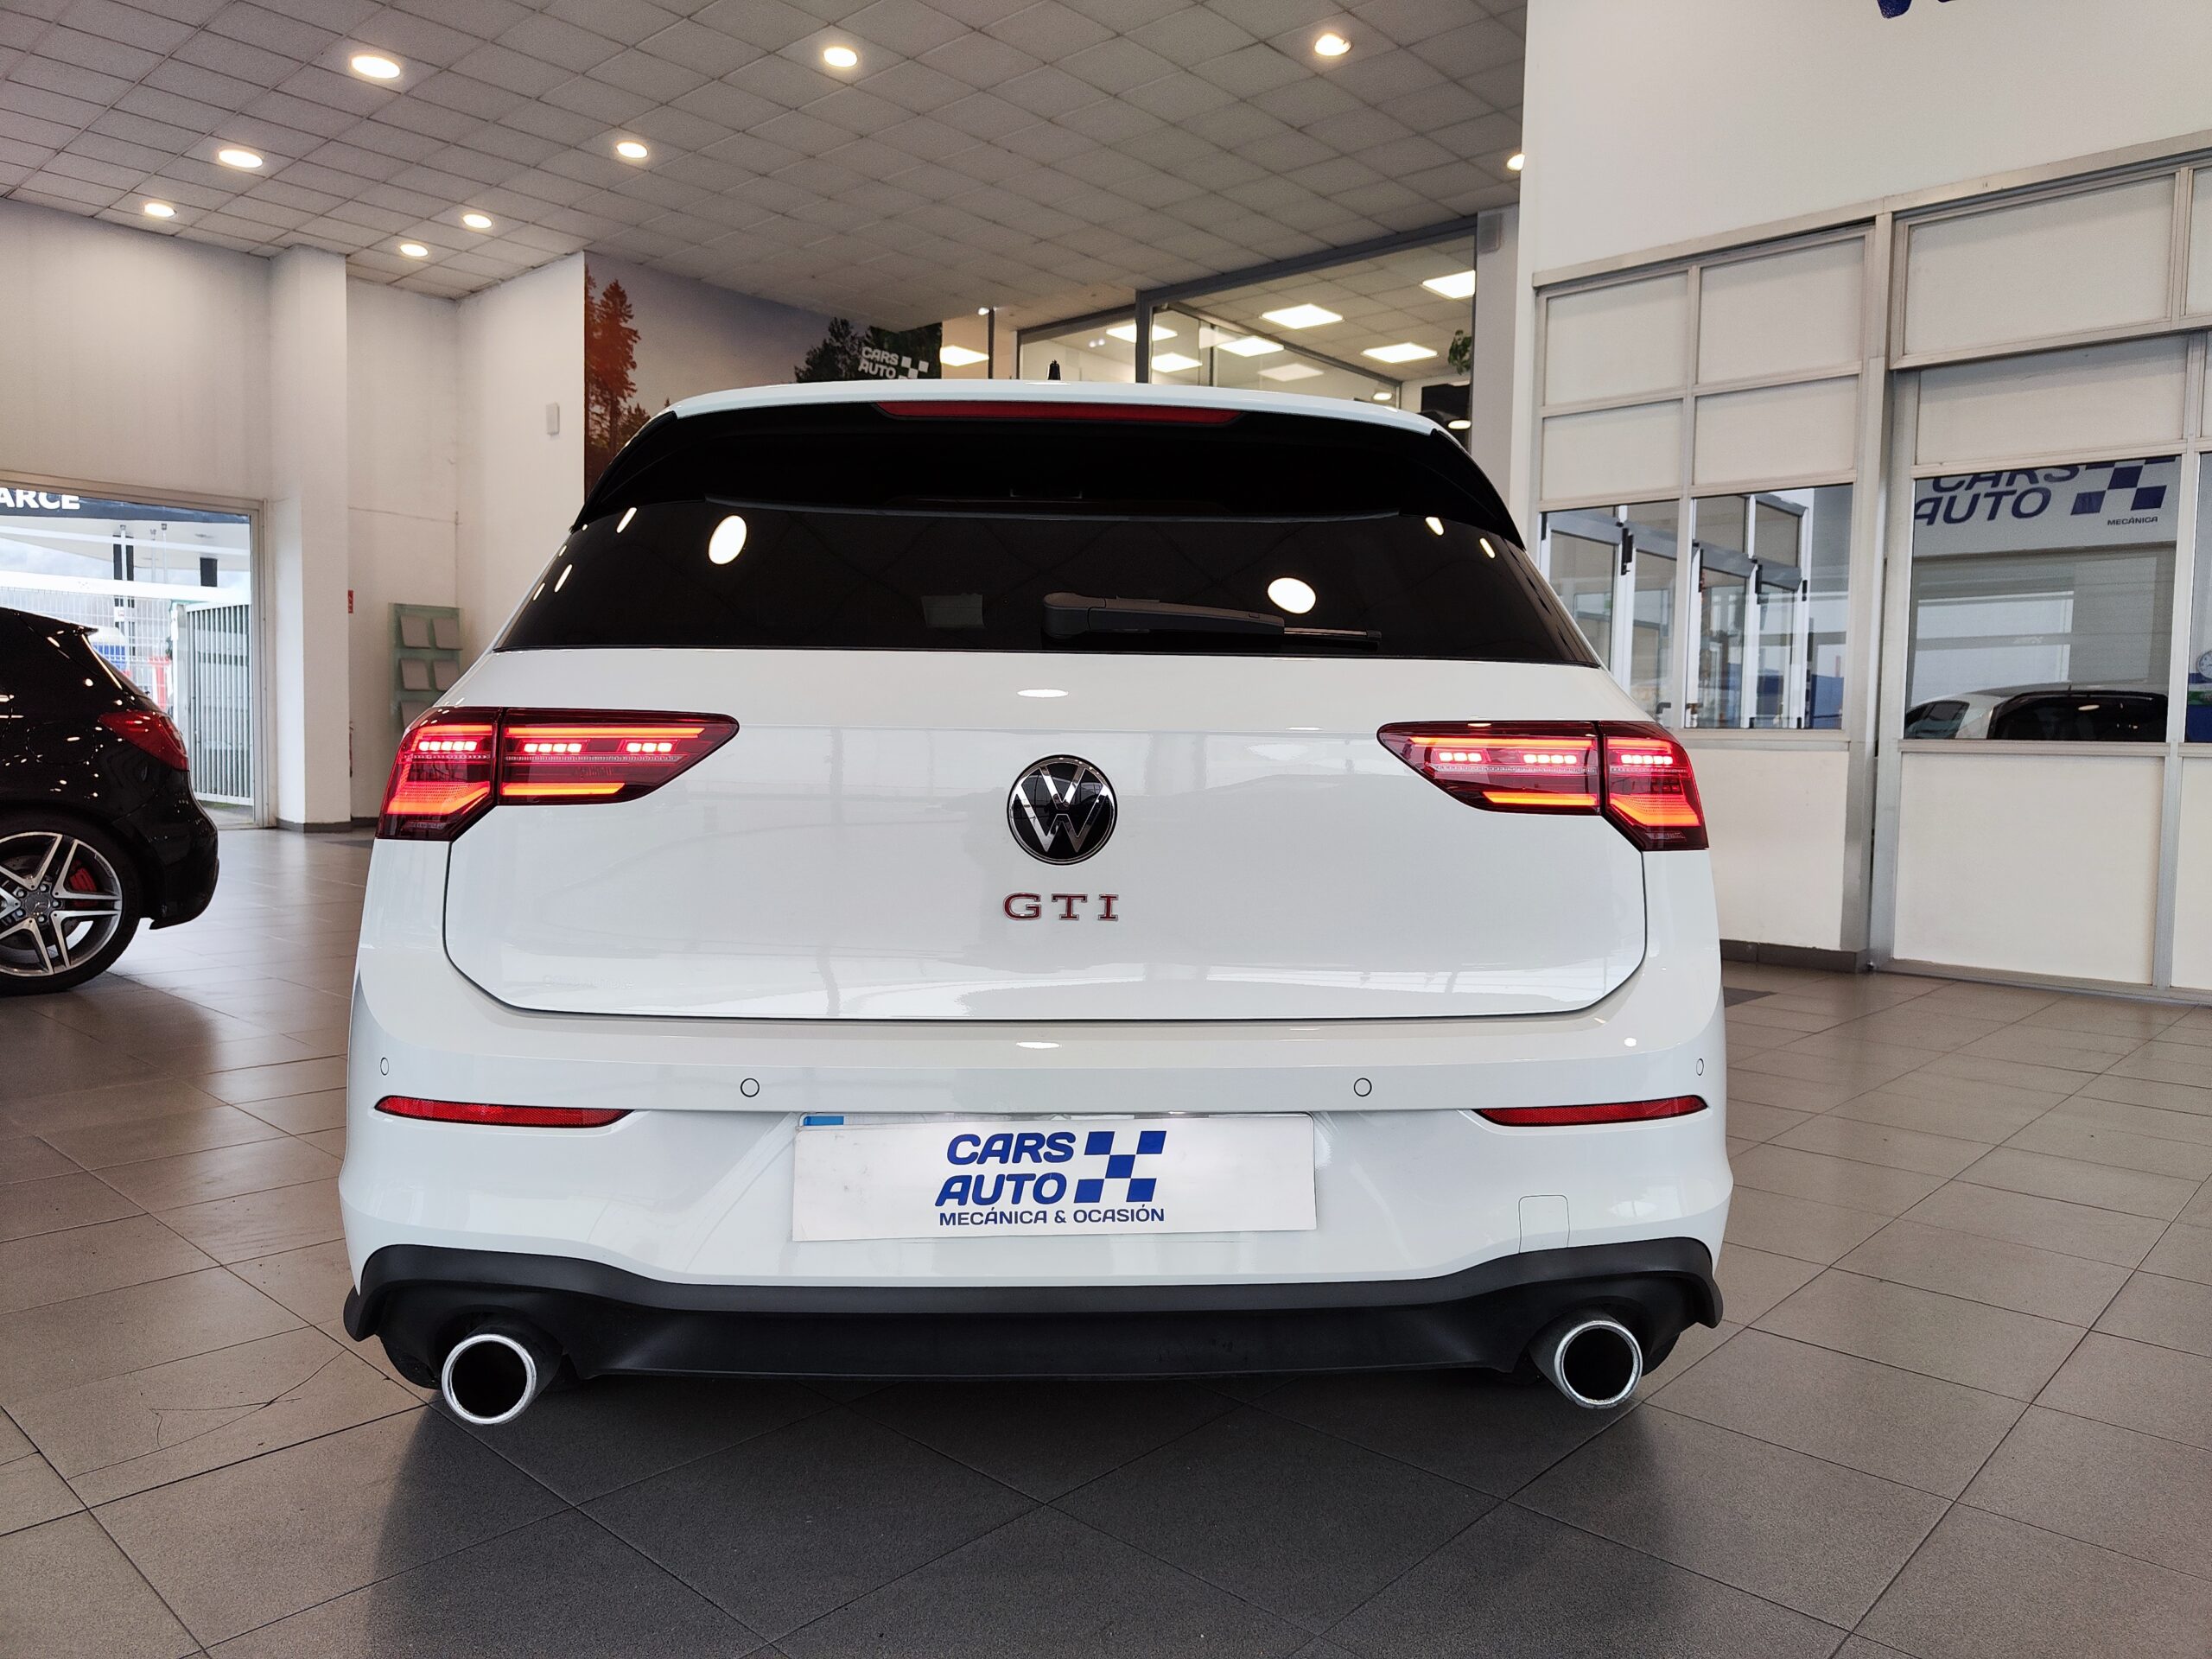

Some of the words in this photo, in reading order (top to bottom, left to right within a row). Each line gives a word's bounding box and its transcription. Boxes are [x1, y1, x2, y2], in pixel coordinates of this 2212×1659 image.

[858, 359, 897, 379] AUTO
[861, 346, 899, 365] CARS
[1914, 486, 2052, 525] AUTO
[1002, 893, 1119, 921] GTI
[946, 1131, 1077, 1165] CARS
[934, 1172, 1067, 1206] AUTO
[939, 1207, 1047, 1226] MECÁNICA
[1054, 1210, 1066, 1224] &
[1073, 1204, 1165, 1223] OCASIÓN
